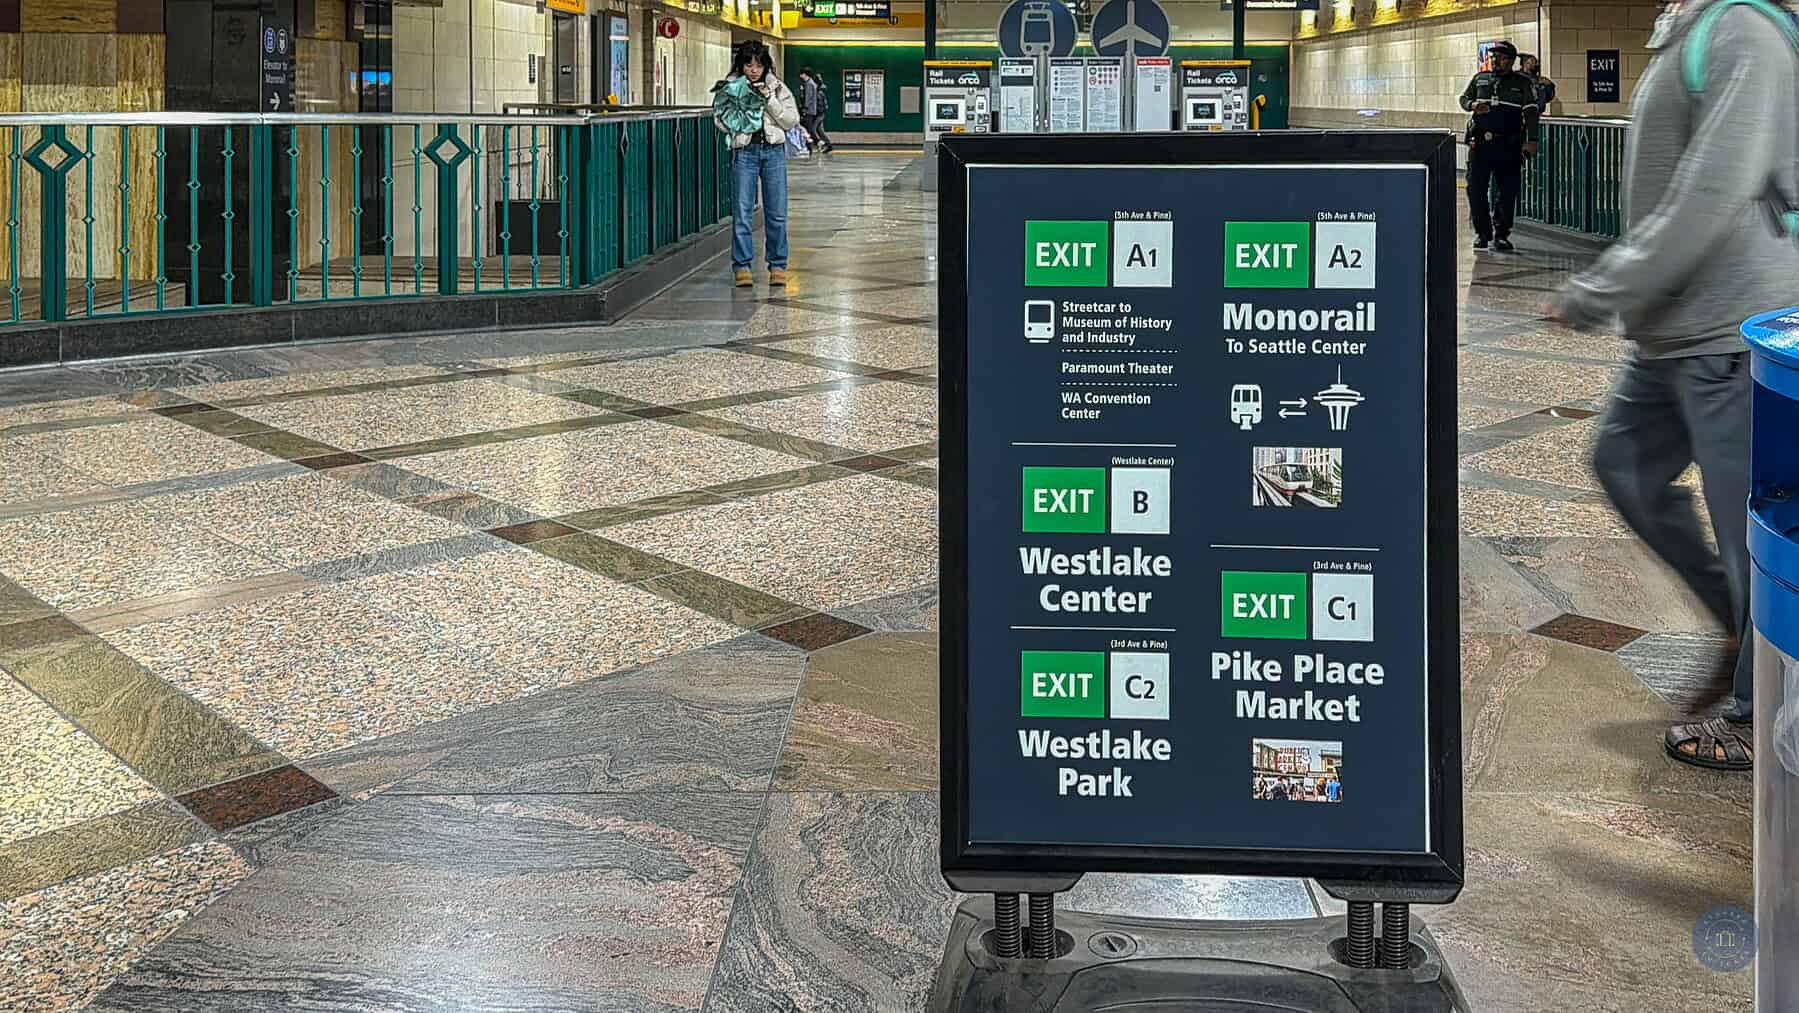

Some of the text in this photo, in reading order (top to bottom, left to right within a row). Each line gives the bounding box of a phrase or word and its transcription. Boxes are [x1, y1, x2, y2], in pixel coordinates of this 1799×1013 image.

[815, 4, 833, 13] EXIT
[1591, 59, 1615, 70] EXIT
[929, 77, 954, 85] Tickets
[958, 75, 980, 85] orca
[1186, 77, 1212, 85] Tickets
[1215, 75, 1238, 85] orca
[1114, 210, 1172, 220] (5th Ave & Pine)
[1317, 211, 1376, 221] (5th Ave & Pine)
[1036, 242, 1157, 268] EXIT A1
[1236, 243, 1362, 269] EXIT A2
[1062, 301, 1132, 313] Streetcar to
[1223, 302, 1376, 331] Monorail
[1062, 316, 1172, 331] Museum of History
[1062, 332, 1136, 346] and Industry
[1226, 338, 1366, 354] To Seattle Center
[1062, 362, 1174, 375] Paramount Theater
[1061, 392, 1151, 405] WA Convention
[1061, 407, 1101, 419] Center
[1111, 456, 1175, 467] (Westlake Center)
[1033, 488, 1149, 514] EXIT B
[1019, 546, 1172, 576] Westlake
[1313, 561, 1372, 572] (3rd Ave & Pine)
[1039, 584, 1153, 613] Center
[1232, 593, 1356, 621] EXIT C1
[1110, 639, 1168, 649] (3rd Ave & Pine)
[1211, 651, 1384, 685] Pike Place
[1032, 672, 1155, 700] EXIT C2
[1236, 690, 1361, 722] Market
[1018, 729, 1171, 760] Westlake
[1059, 767, 1133, 797] Park
